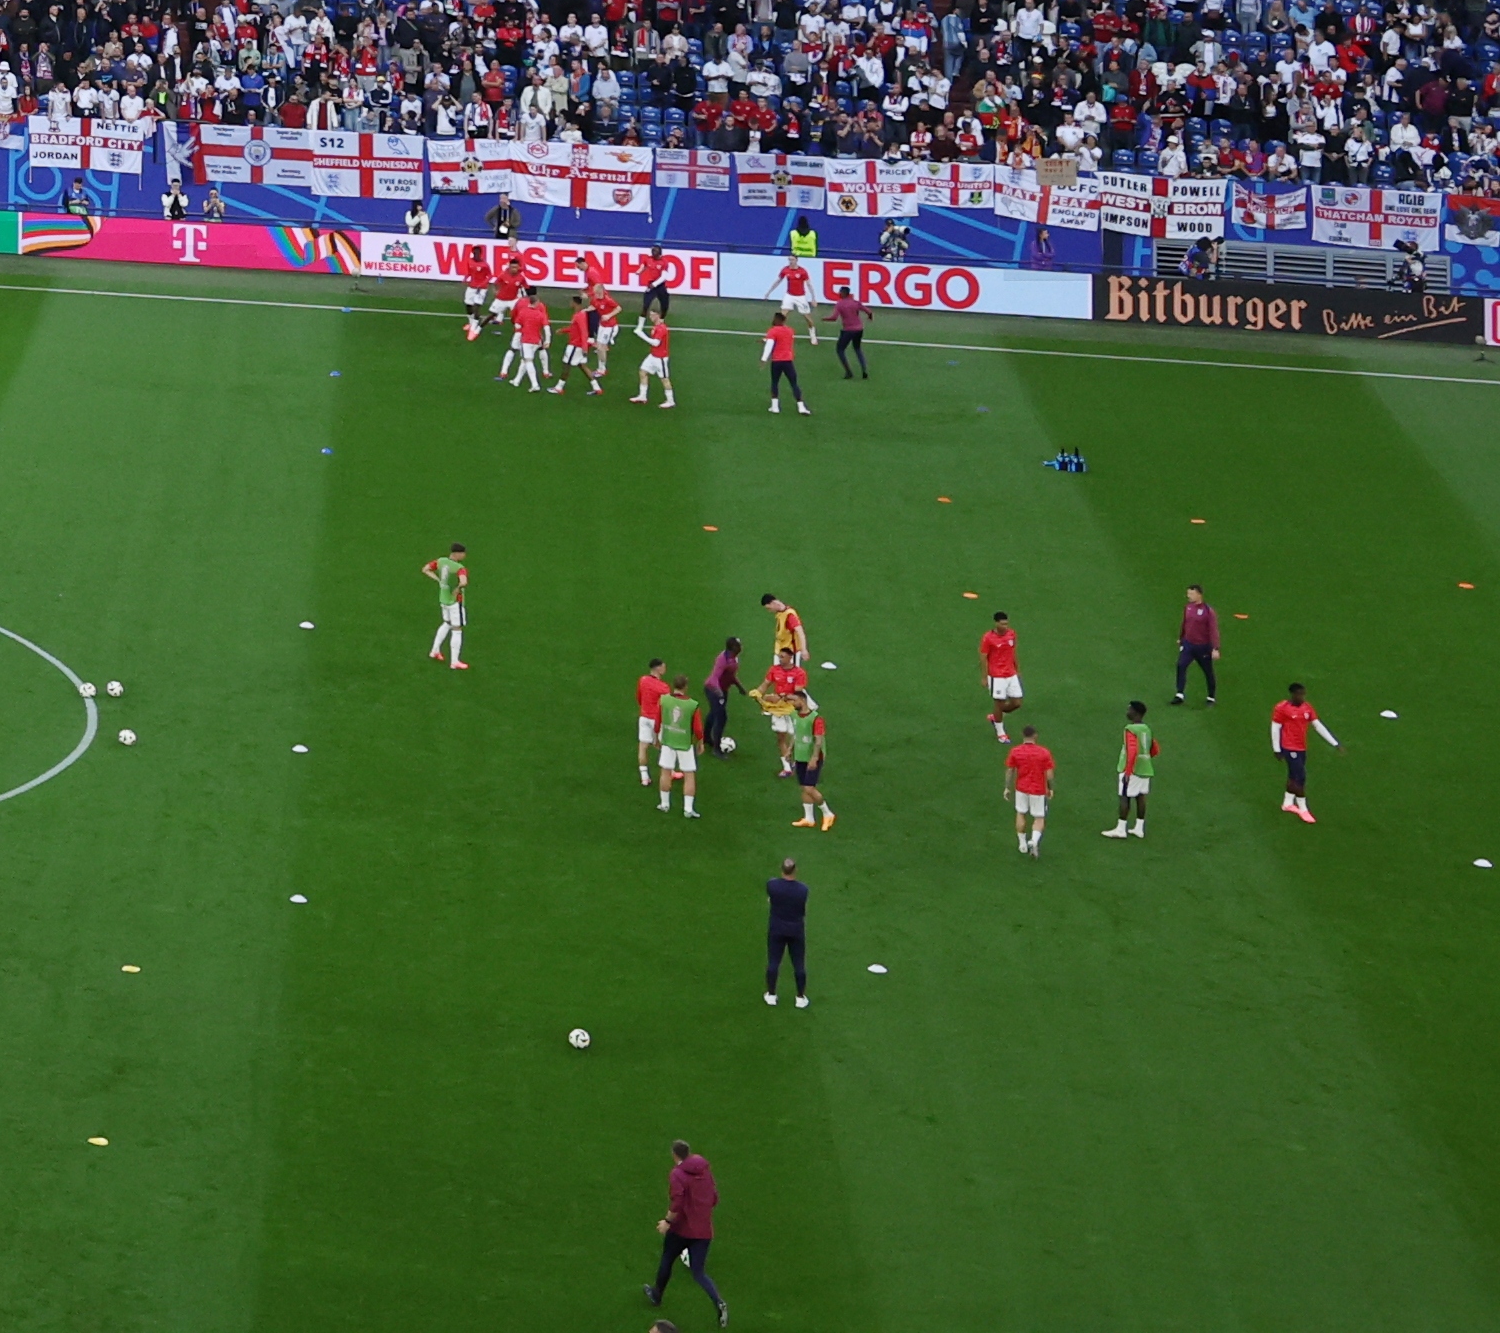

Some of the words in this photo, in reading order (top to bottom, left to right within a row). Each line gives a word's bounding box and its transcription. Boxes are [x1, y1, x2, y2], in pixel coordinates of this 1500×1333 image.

[97, 122, 138, 133] NETTIE
[31, 134, 104, 147] BRADFORD
[108, 138, 141, 150] CITY
[320, 137, 345, 148] S12
[32, 151, 78, 161] JORDAN
[313, 157, 360, 167] SHEFFIELD
[361, 159, 419, 170] WEDNESDAY
[528, 162, 560, 176] The
[565, 166, 632, 183] Arsenal
[833, 167, 858, 176] JACK
[880, 168, 913, 176] PRICEY
[379, 178, 396, 186] EVIE
[843, 182, 902, 194] WOLVES
[1103, 175, 1148, 192] CUTLER
[1002, 185, 1043, 202] MATT
[1049, 194, 1088, 208] PEAT
[1173, 185, 1221, 196] POWELL
[1102, 193, 1148, 210] WEST
[1173, 202, 1221, 215] BROM
[1052, 208, 1096, 219] ENGLAND
[1317, 208, 1384, 223] THATCHAM
[1387, 214, 1437, 227] ROYALS
[1060, 217, 1086, 226] AWAY
[1177, 222, 1213, 233] WOOD
[364, 260, 432, 273] WIESENHOF
[823, 261, 980, 310] ERGO
[1105, 275, 1309, 331] Bitburger
[1322, 309, 1375, 335] Bitte
[1379, 309, 1417, 324] ein
[1422, 295, 1466, 319] Bit
